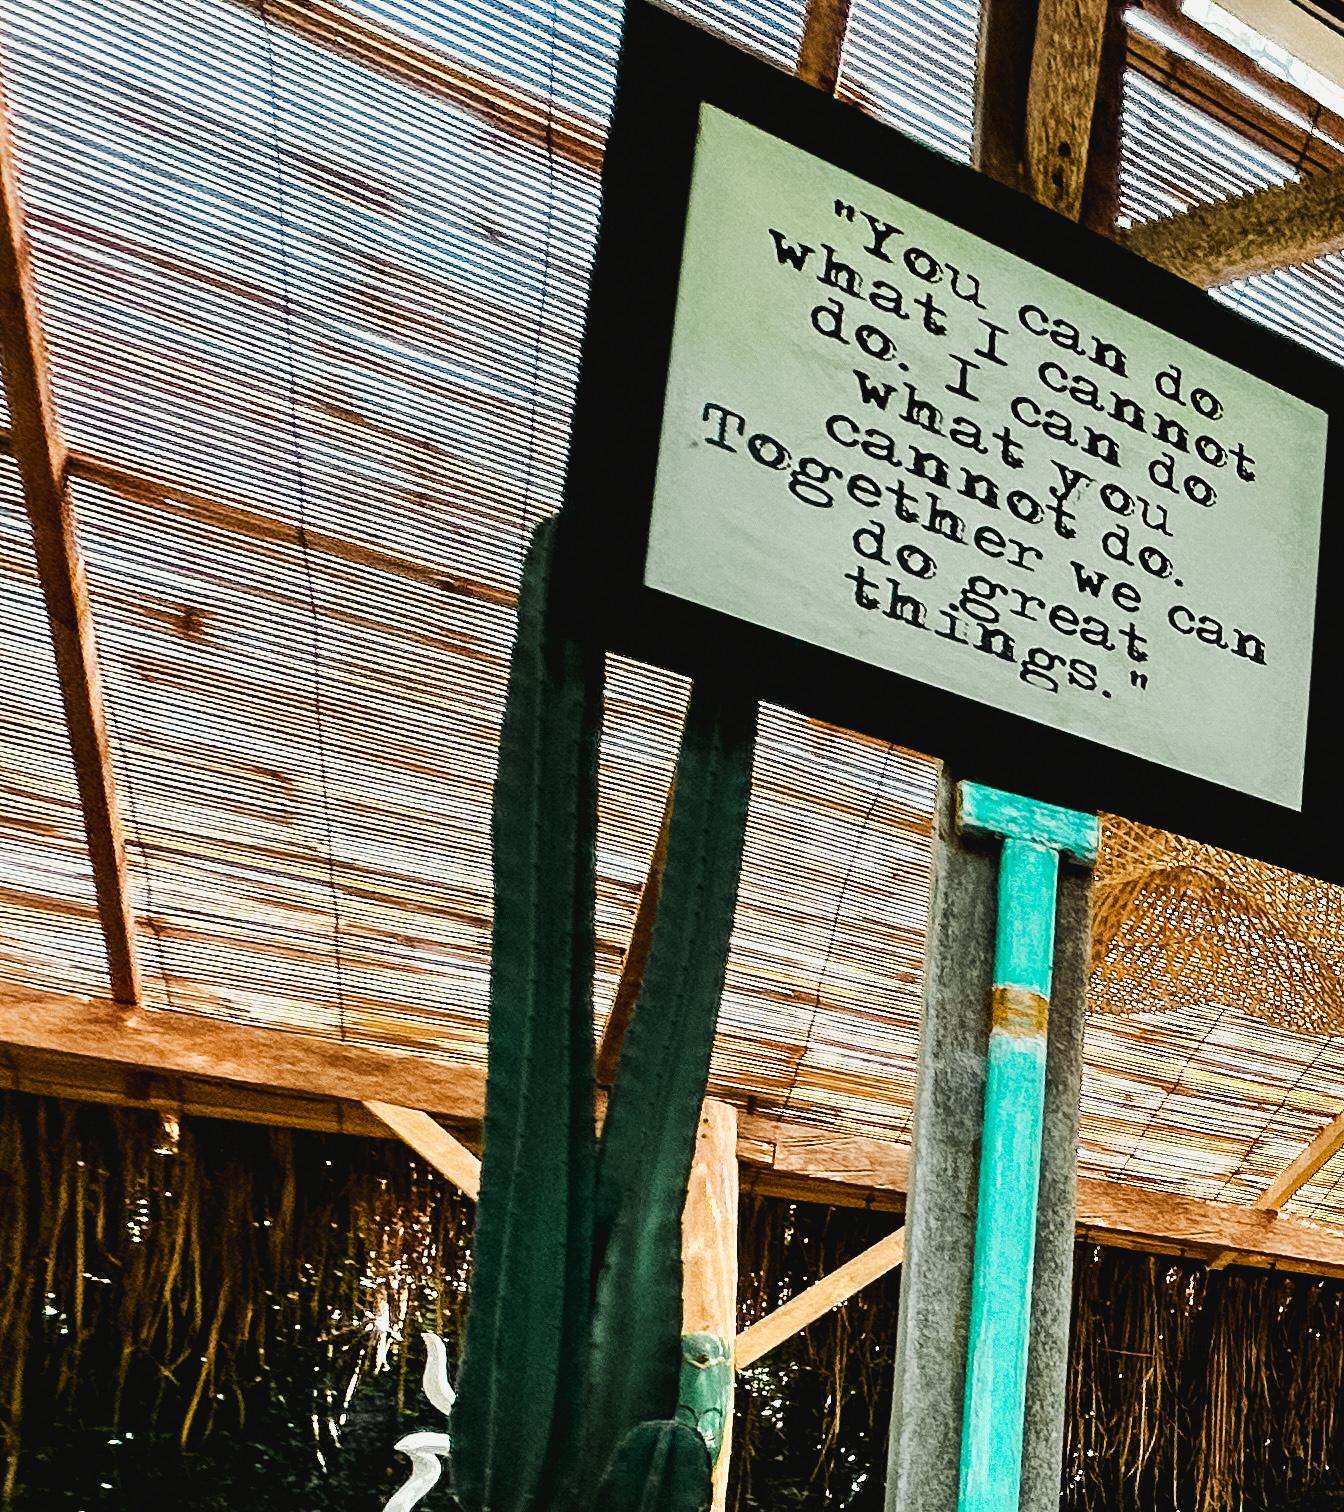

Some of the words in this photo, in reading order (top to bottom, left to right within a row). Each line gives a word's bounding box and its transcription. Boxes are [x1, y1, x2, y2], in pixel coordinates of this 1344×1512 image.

[768, 228, 948, 337] what
[973, 317, 1009, 367] I
[1038, 361, 1256, 483] cannot
[810, 296, 910, 372] do.
[944, 353, 981, 402] I
[1010, 396, 1122, 468] can
[1148, 451, 1218, 508] do
[834, 199, 987, 310] "You
[1018, 304, 1129, 379] can
[1154, 364, 1224, 421] do
[702, 402, 1044, 573] Together
[1069, 560, 1142, 613] we
[1167, 605, 1268, 666] can
[825, 414, 1078, 540] cannot
[1101, 523, 1184, 588] do.
[852, 368, 1025, 470] what
[1048, 459, 1174, 537] you
[844, 565, 1149, 699] things."
[852, 519, 938, 580] do
[958, 575, 1149, 663] great
